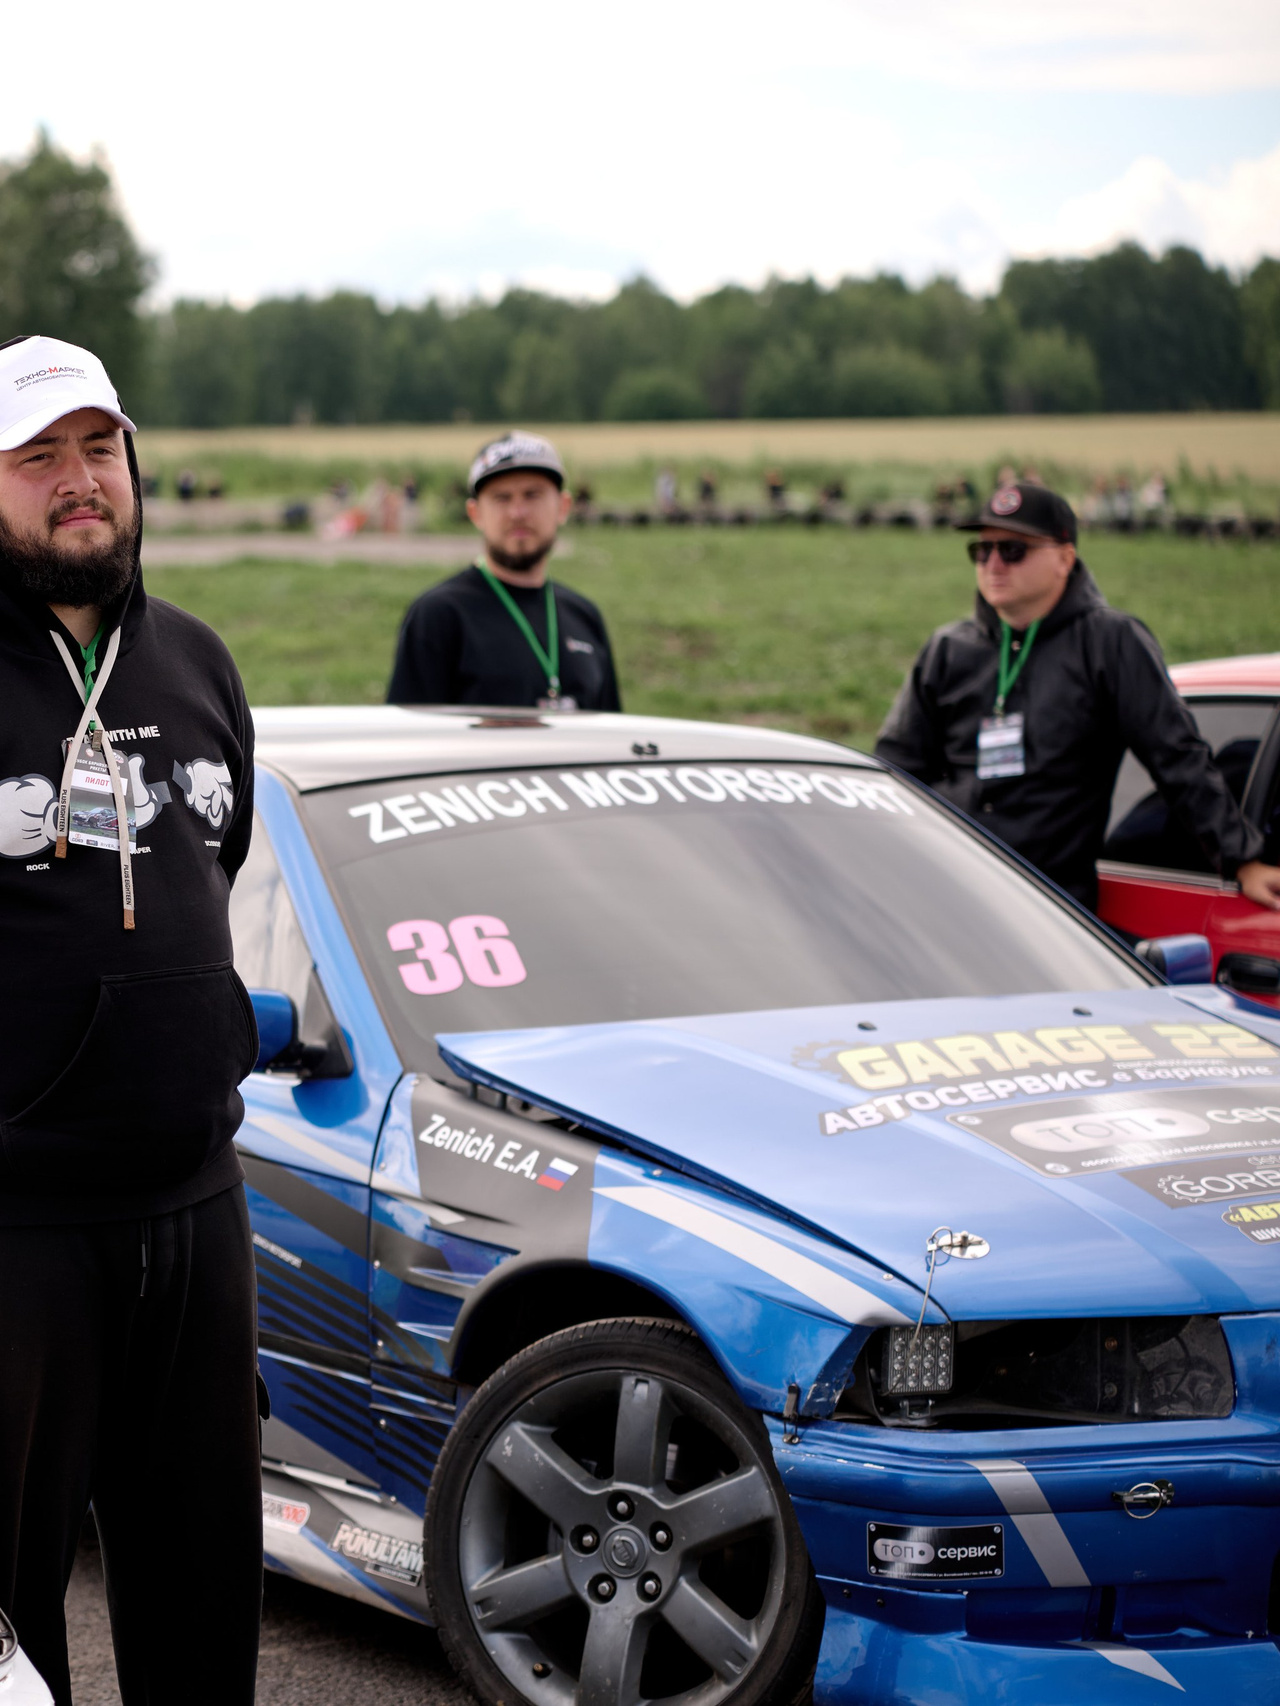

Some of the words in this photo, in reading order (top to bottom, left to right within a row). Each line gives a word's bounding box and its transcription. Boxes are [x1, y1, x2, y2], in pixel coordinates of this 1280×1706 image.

[14, 366, 86, 386] ТЕХНО-МАРКЕТ
[138, 725, 161, 738] ME
[85, 776, 110, 787] ПИЛОТ
[349, 775, 568, 844] ZENICH
[559, 766, 916, 817] MOTORSPORT
[59, 806, 67, 833] EIGHTEEN
[26, 863, 50, 872] ROCK
[124, 880, 132, 906] EIGHTEEN
[386, 914, 527, 996] 36
[837, 1024, 1157, 1090] GARAGE
[825, 1069, 1108, 1136] АВТОСЕРВИС
[1036, 1116, 1153, 1144] ТОП
[419, 1113, 495, 1164] Zenich
[493, 1140, 539, 1181] E.A.
[881, 1543, 914, 1558] ТОП
[937, 1544, 997, 1561] сервис
